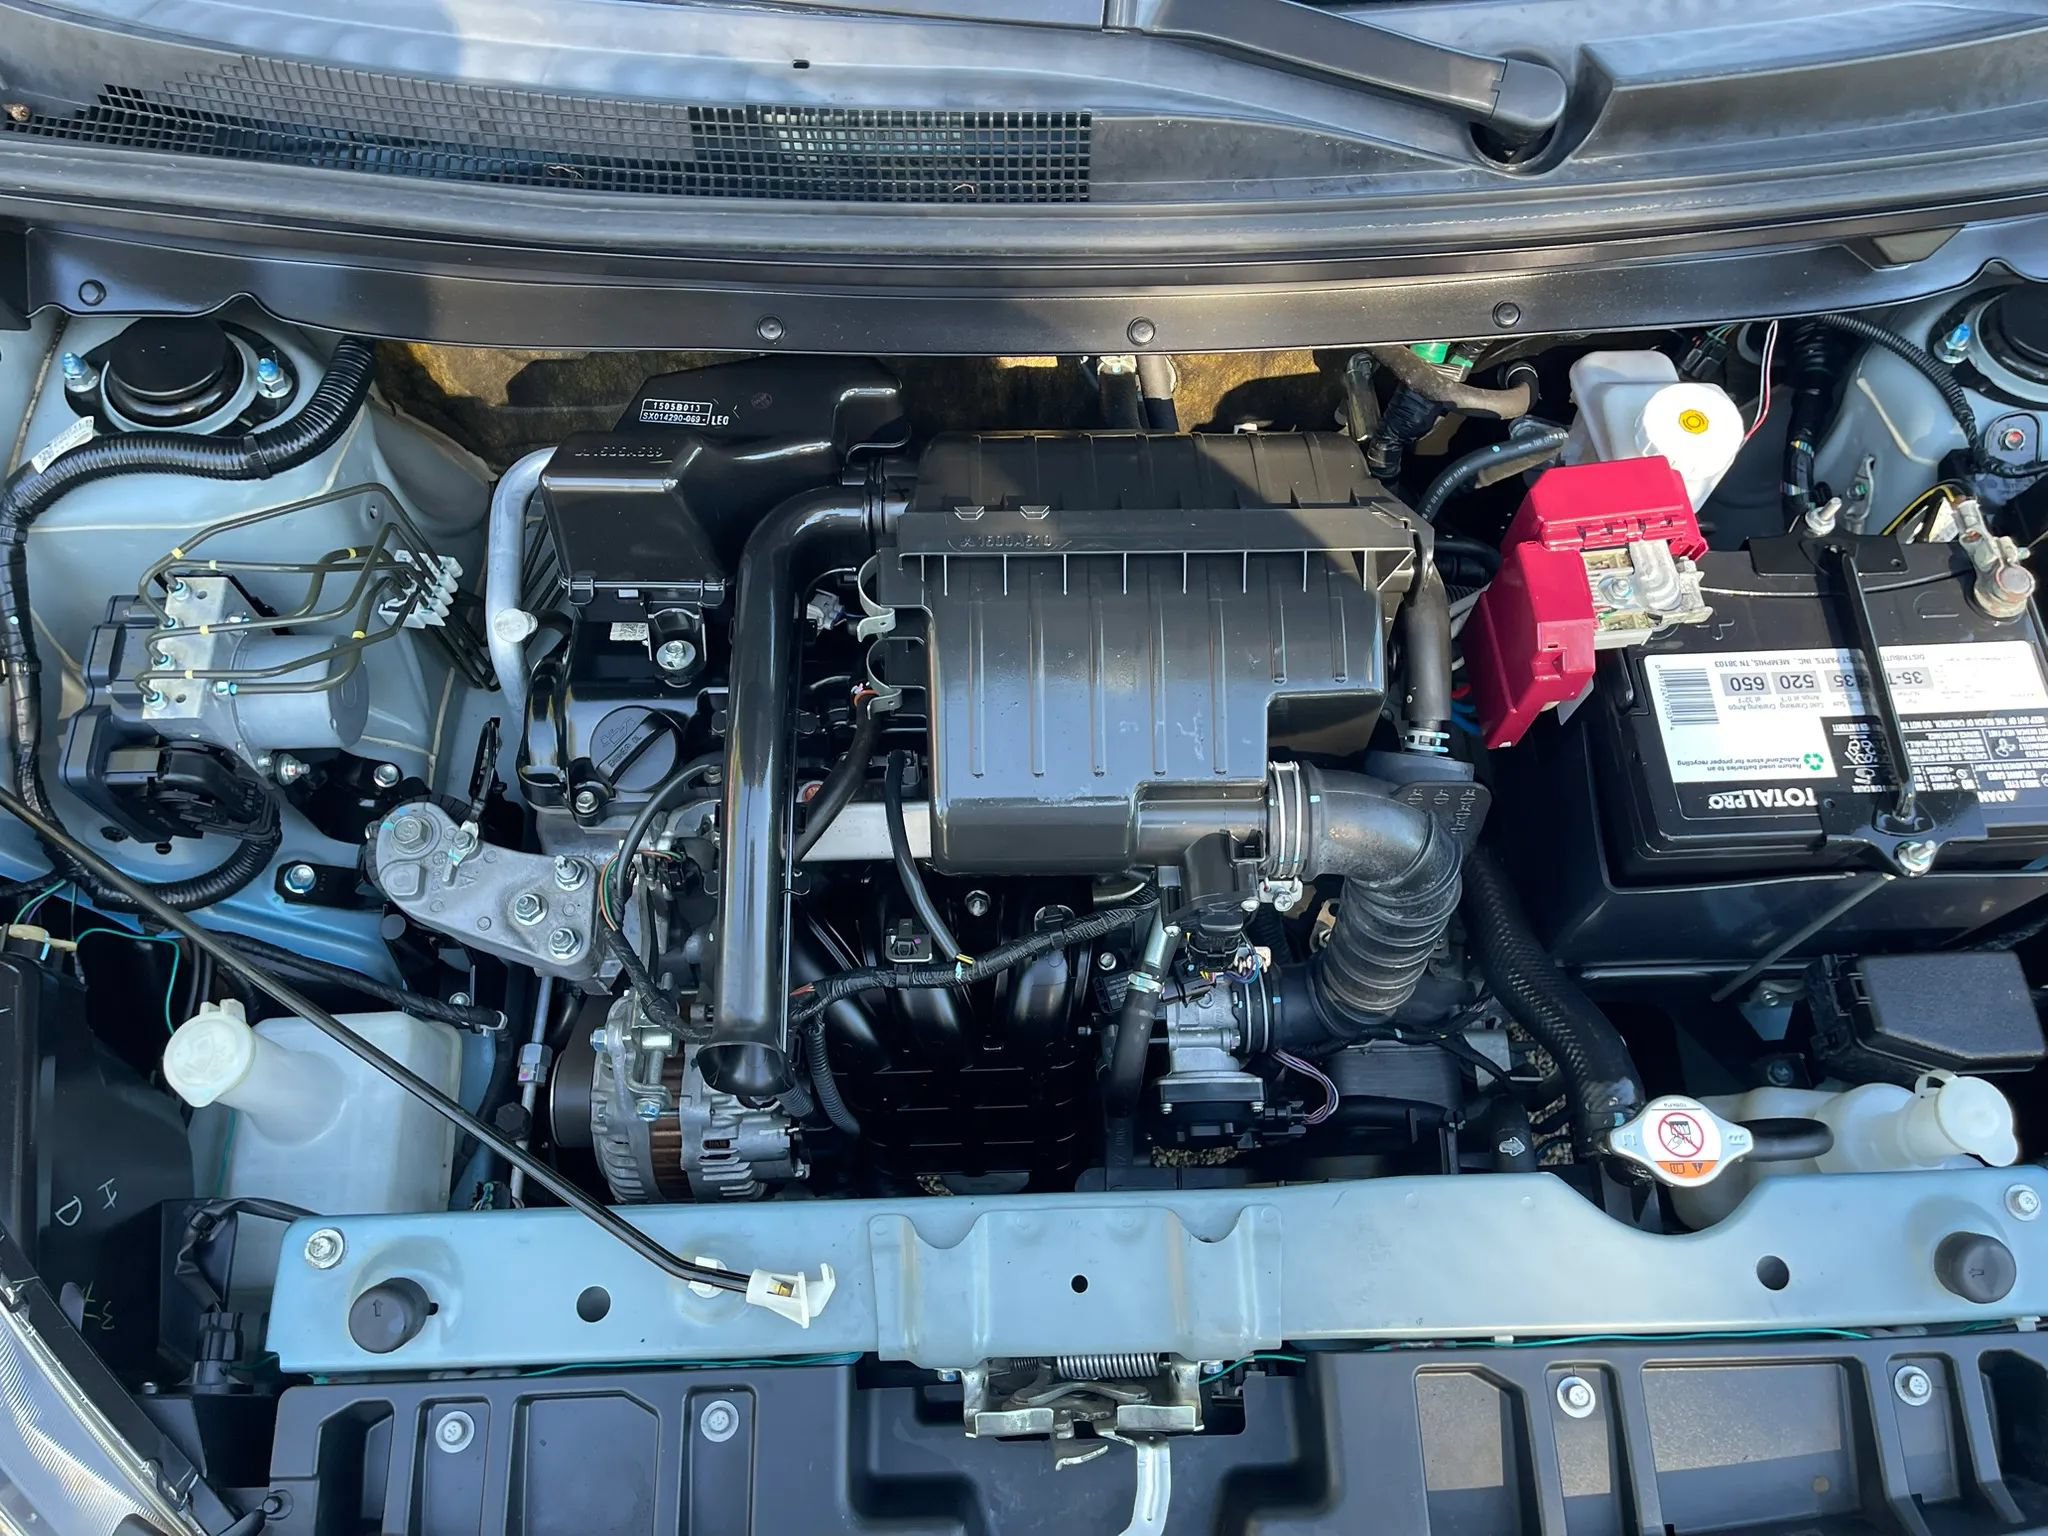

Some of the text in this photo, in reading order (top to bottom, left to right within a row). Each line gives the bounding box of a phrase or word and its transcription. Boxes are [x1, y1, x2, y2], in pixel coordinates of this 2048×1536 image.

[1714, 660, 1738, 668] 38103
[1729, 676, 1765, 692] 650
[1779, 674, 1815, 690] 520
[1677, 759, 1709, 767] recycling
